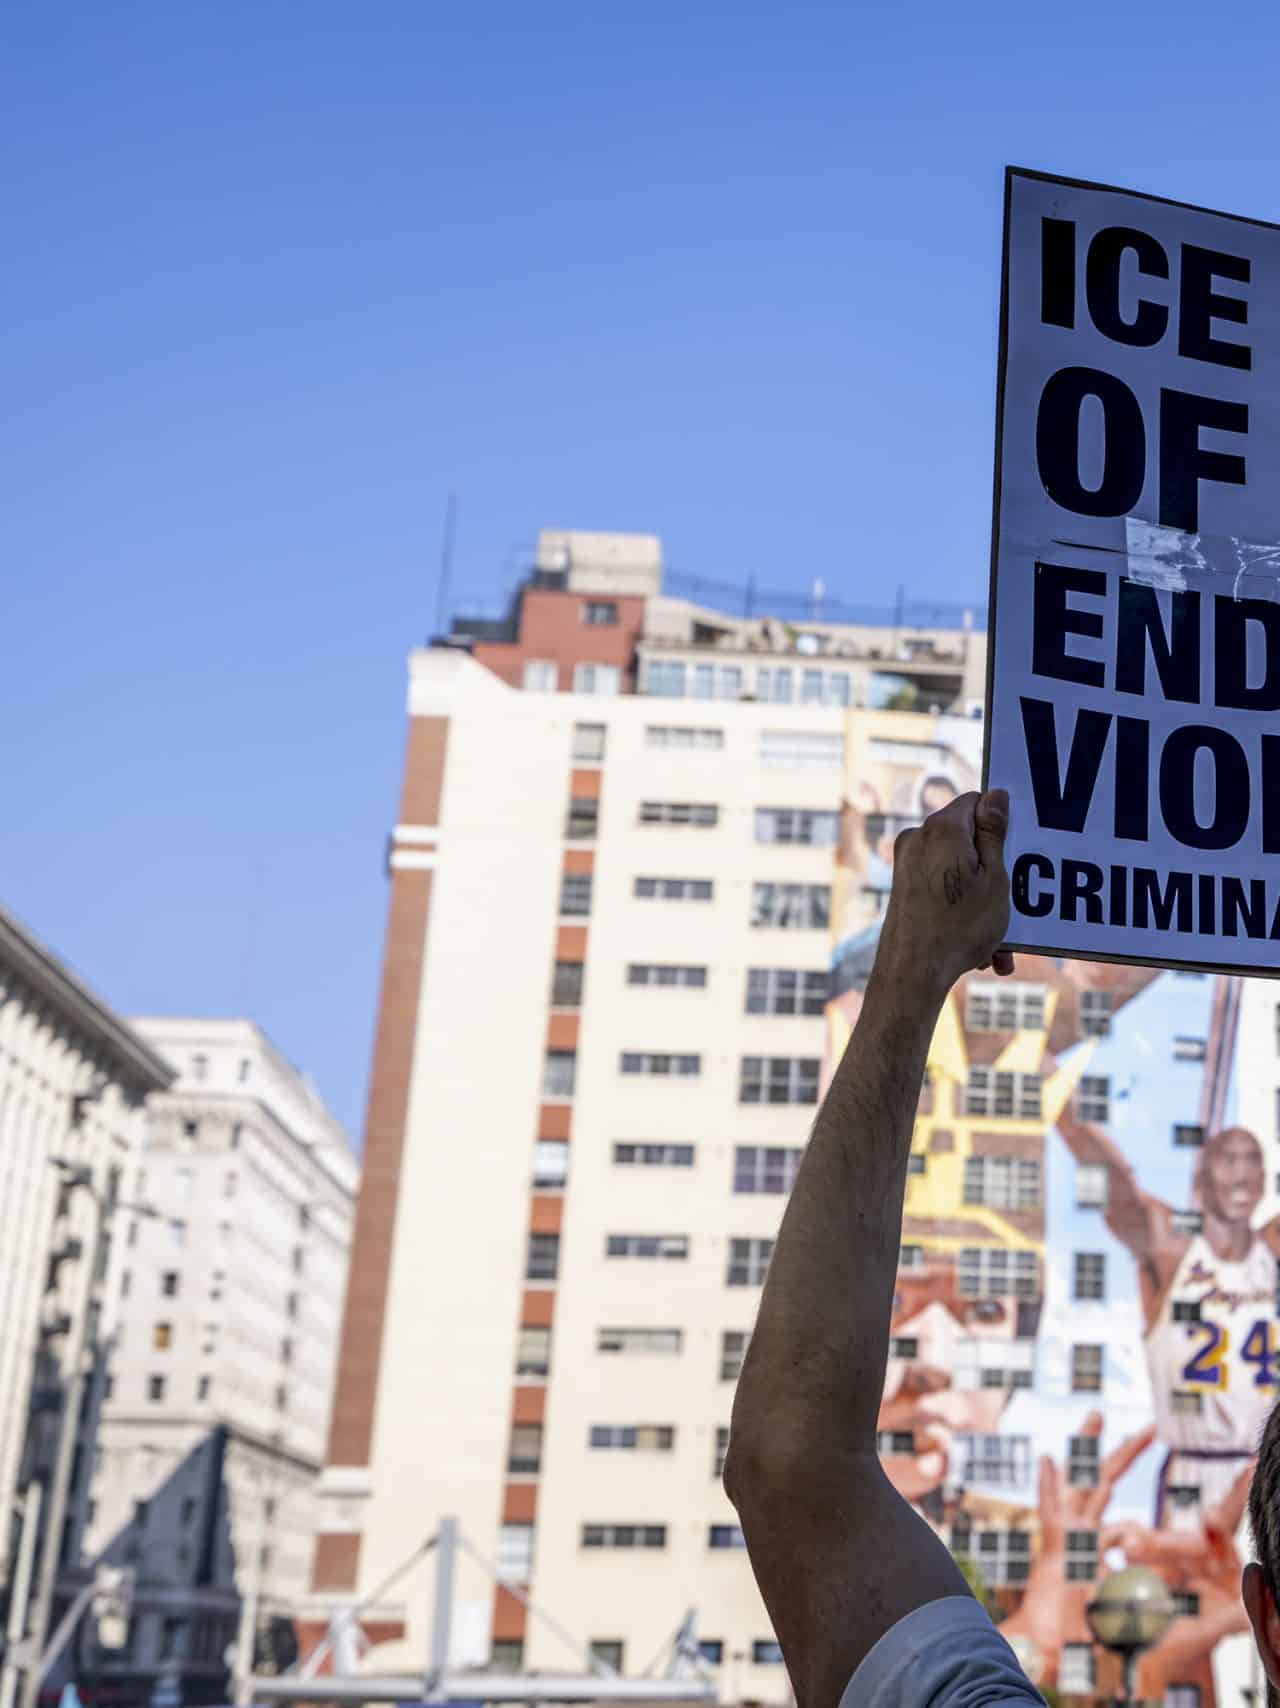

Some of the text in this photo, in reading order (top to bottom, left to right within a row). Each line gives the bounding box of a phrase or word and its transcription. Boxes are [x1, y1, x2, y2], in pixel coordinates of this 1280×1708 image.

[1041, 217, 1252, 371] ICE
[1035, 366, 1249, 535] OF
[1183, 1319, 1276, 1392] 24
